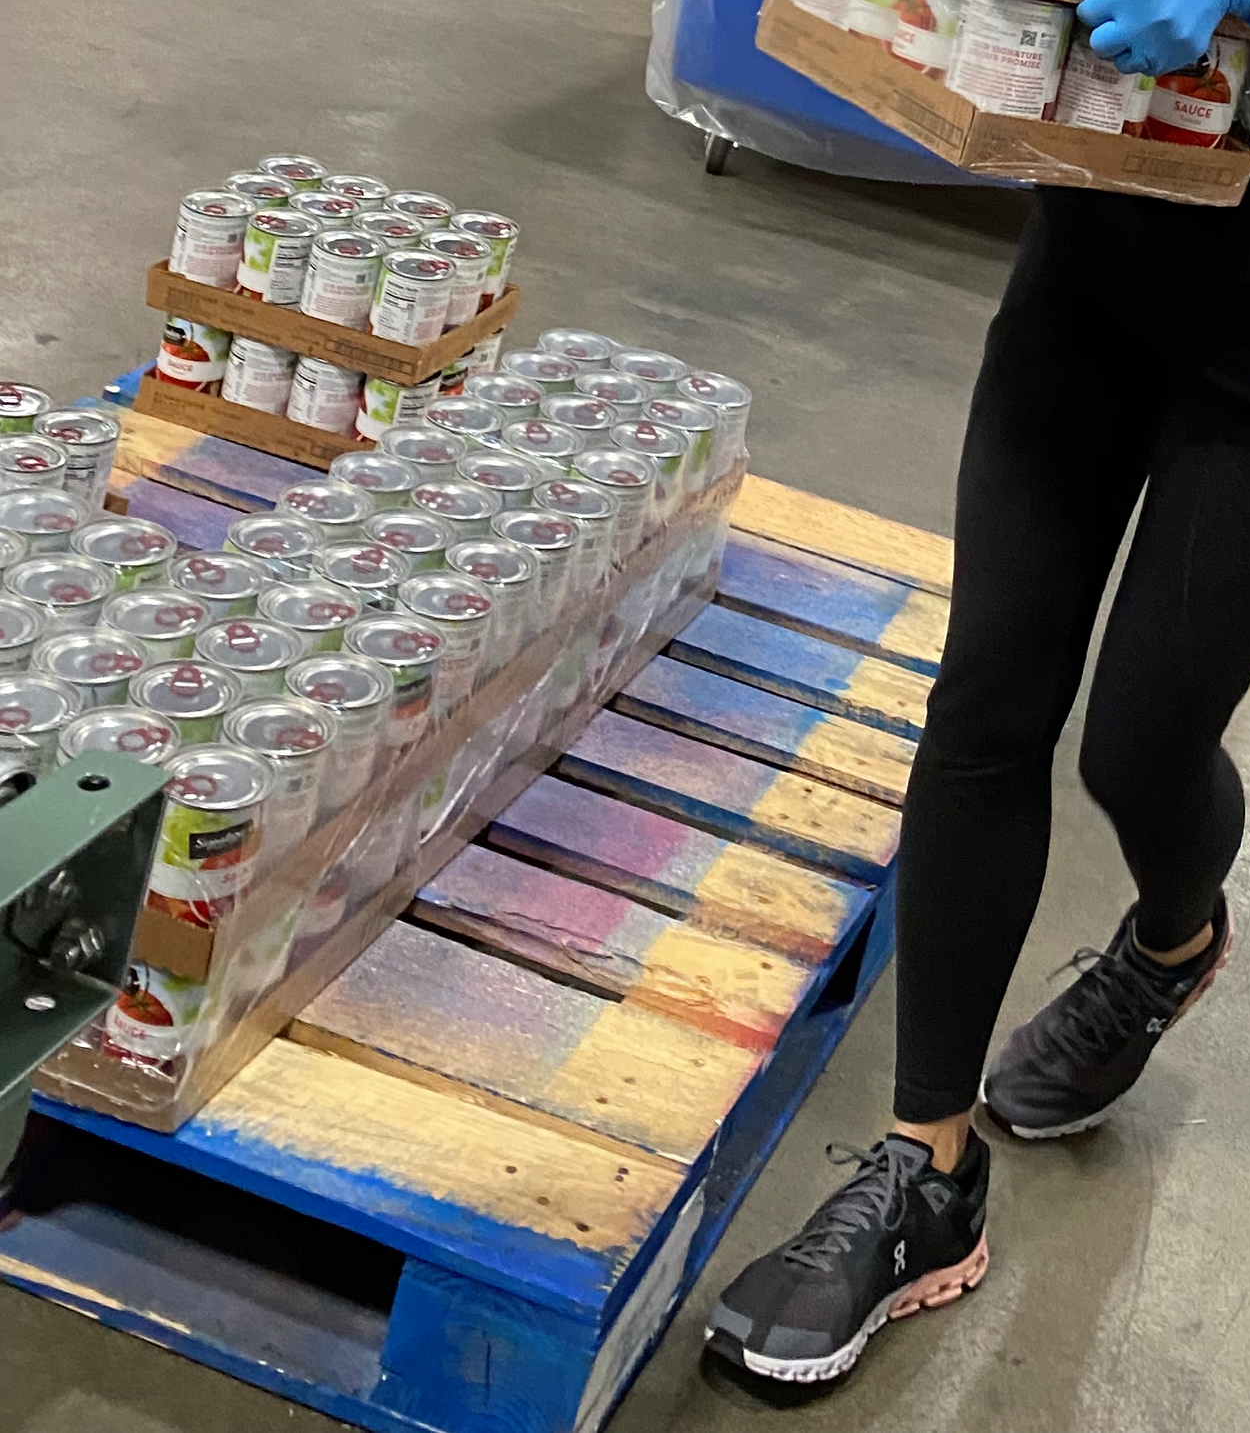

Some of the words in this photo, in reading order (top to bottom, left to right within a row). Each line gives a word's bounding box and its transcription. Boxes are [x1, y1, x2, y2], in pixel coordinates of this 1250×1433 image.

[991, 45, 1043, 61] SIGNATURE
[1001, 55, 1042, 69] PROMISE
[1173, 100, 1214, 119] SAUCE
